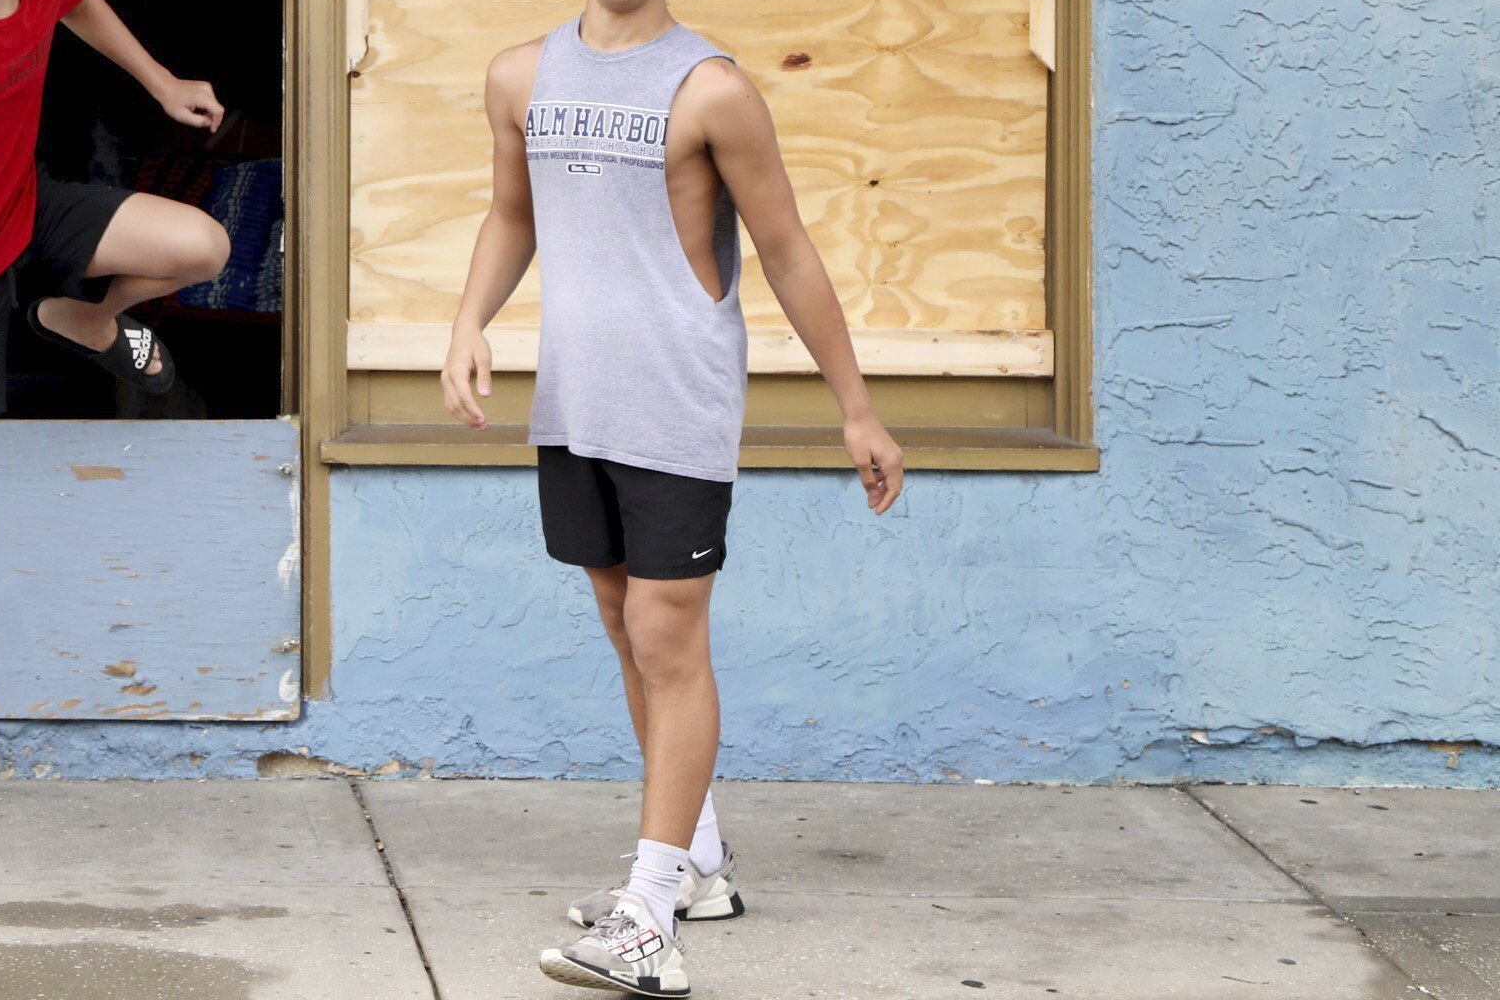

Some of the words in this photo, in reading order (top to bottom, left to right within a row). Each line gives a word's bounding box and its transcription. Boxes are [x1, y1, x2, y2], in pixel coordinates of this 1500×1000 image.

[588, 140, 615, 151] HIGH
[550, 151, 580, 160] WELLNESS
[594, 152, 618, 164] MEDICAL
[620, 156, 664, 170] PROFESSIONS
[134, 327, 152, 370] adidas
